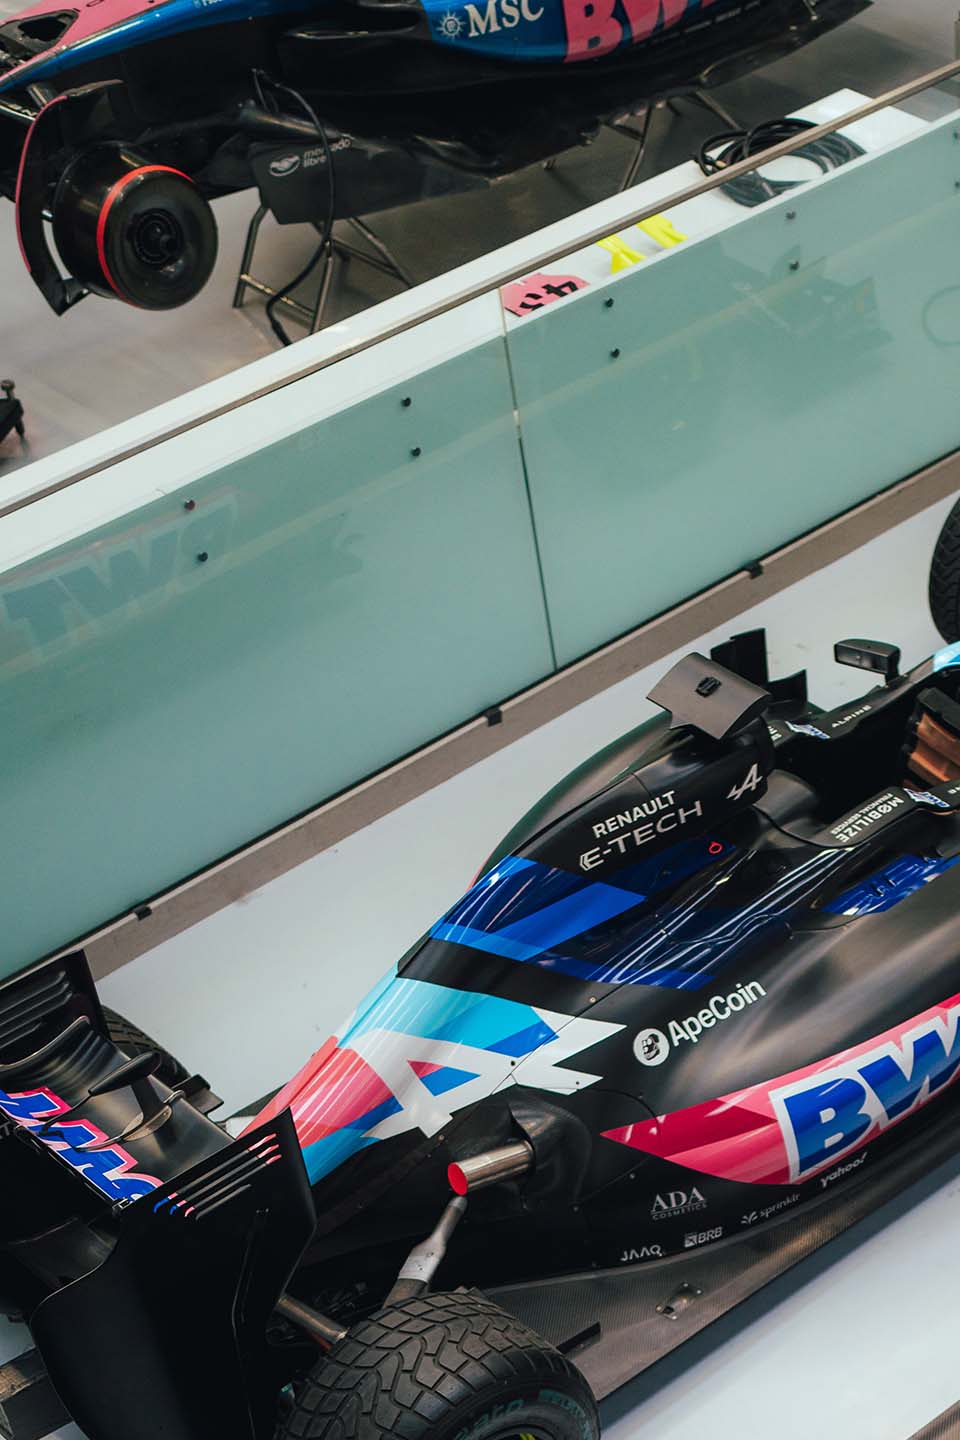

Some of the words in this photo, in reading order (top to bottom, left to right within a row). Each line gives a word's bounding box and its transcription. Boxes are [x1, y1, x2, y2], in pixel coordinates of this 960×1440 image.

[592, 790, 675, 839] RENAULT
[580, 801, 702, 871] E-TECH
[668, 979, 766, 1047] ApeCoin
[820, 1152, 867, 1188] yahoo!
[650, 1187, 707, 1213] ADA
[652, 1206, 707, 1221] COSMETICS
[697, 1227, 723, 1246] BRB
